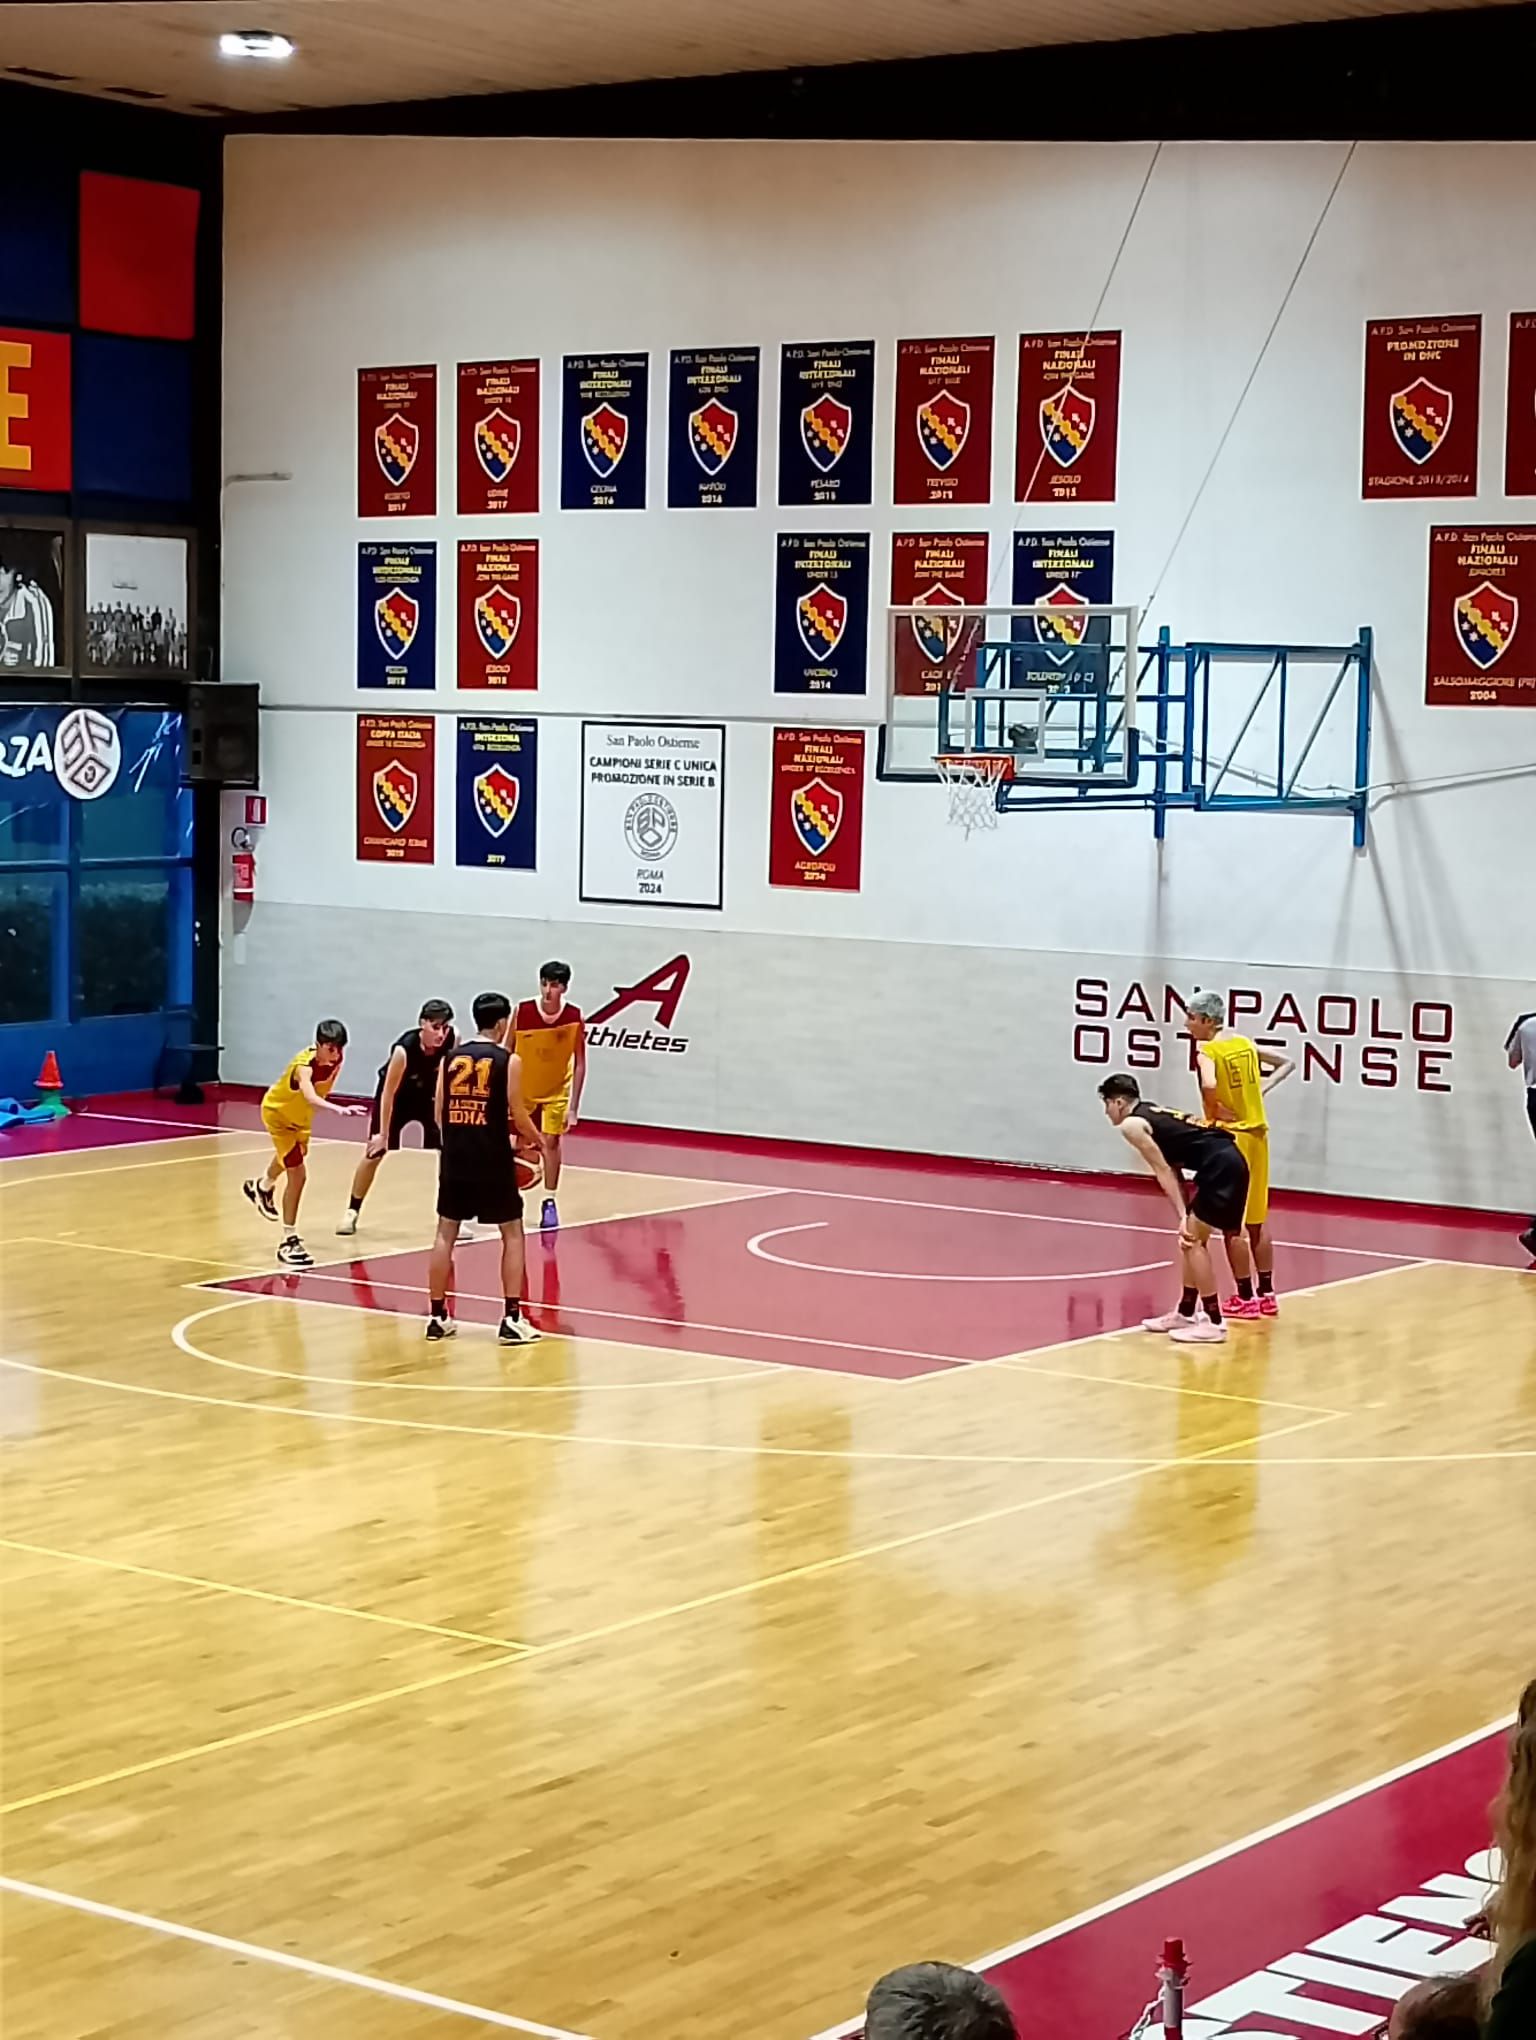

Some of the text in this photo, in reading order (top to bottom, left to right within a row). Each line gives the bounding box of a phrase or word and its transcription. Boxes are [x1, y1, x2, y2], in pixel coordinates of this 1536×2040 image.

[1471, 544, 1505, 554] FINALI
[1457, 555, 1518, 566] NAZIONALI
[809, 680, 831, 689] 2014
[1470, 690, 1497, 700] 2004
[607, 734, 700, 749] San Paolo Ostiense
[589, 756, 716, 771] CAMPIONI SERIE C UNICA
[591, 772, 715, 787] PROMOZIONE IN SERIE B
[637, 869, 664, 880] ROMA
[638, 883, 662, 894] 2024
[1075, 979, 1453, 1042] SAN PAOLO
[583, 1026, 689, 1053] thletes
[448, 1055, 494, 1097] 21
